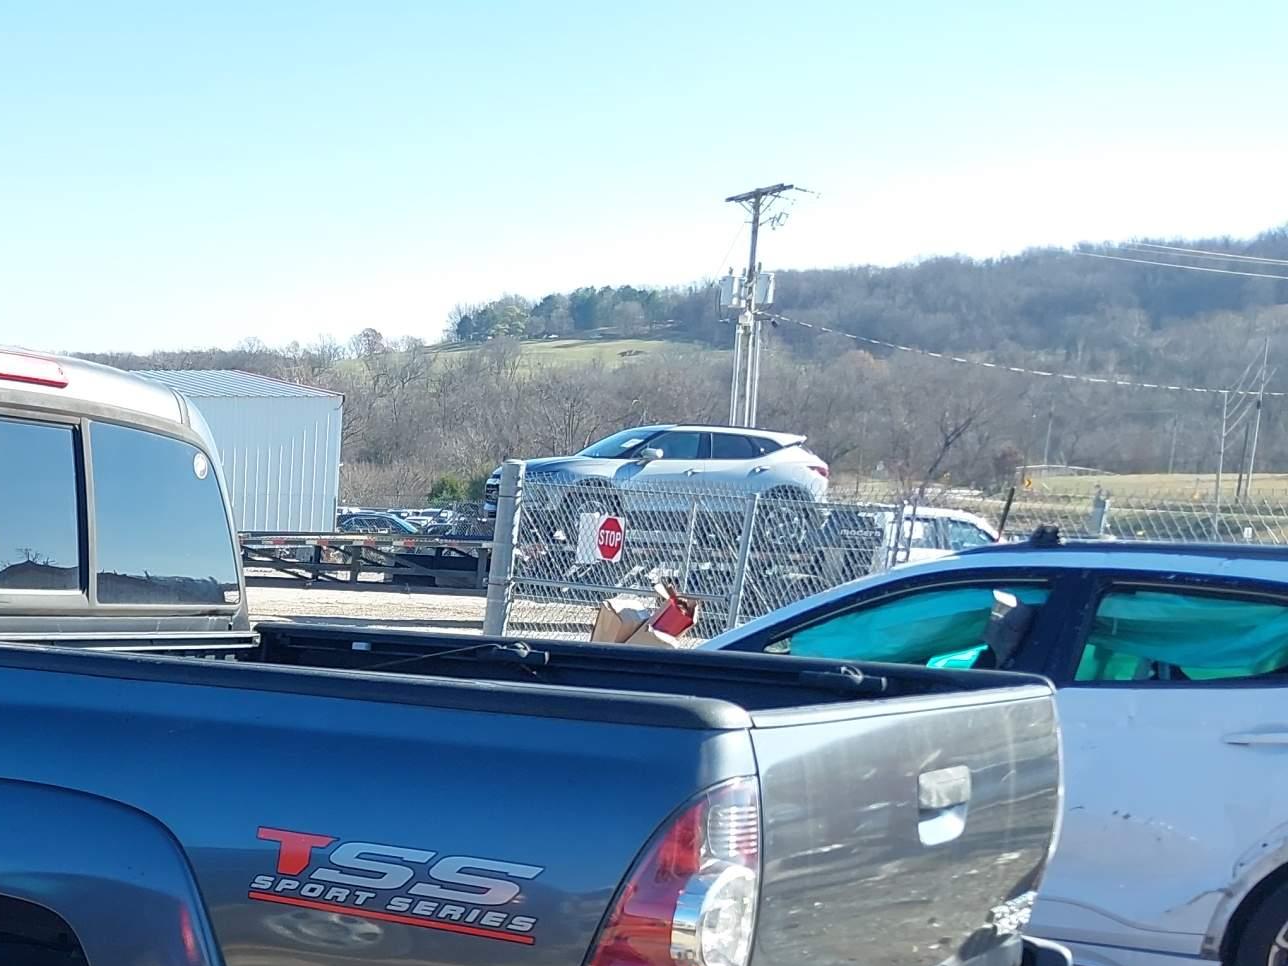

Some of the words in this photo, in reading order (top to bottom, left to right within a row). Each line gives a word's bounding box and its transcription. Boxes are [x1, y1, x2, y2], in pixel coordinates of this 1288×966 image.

[598, 529, 622, 548] STOP
[256, 826, 545, 906] TSS
[250, 874, 376, 905] SPORT
[385, 896, 537, 932] SERIES
